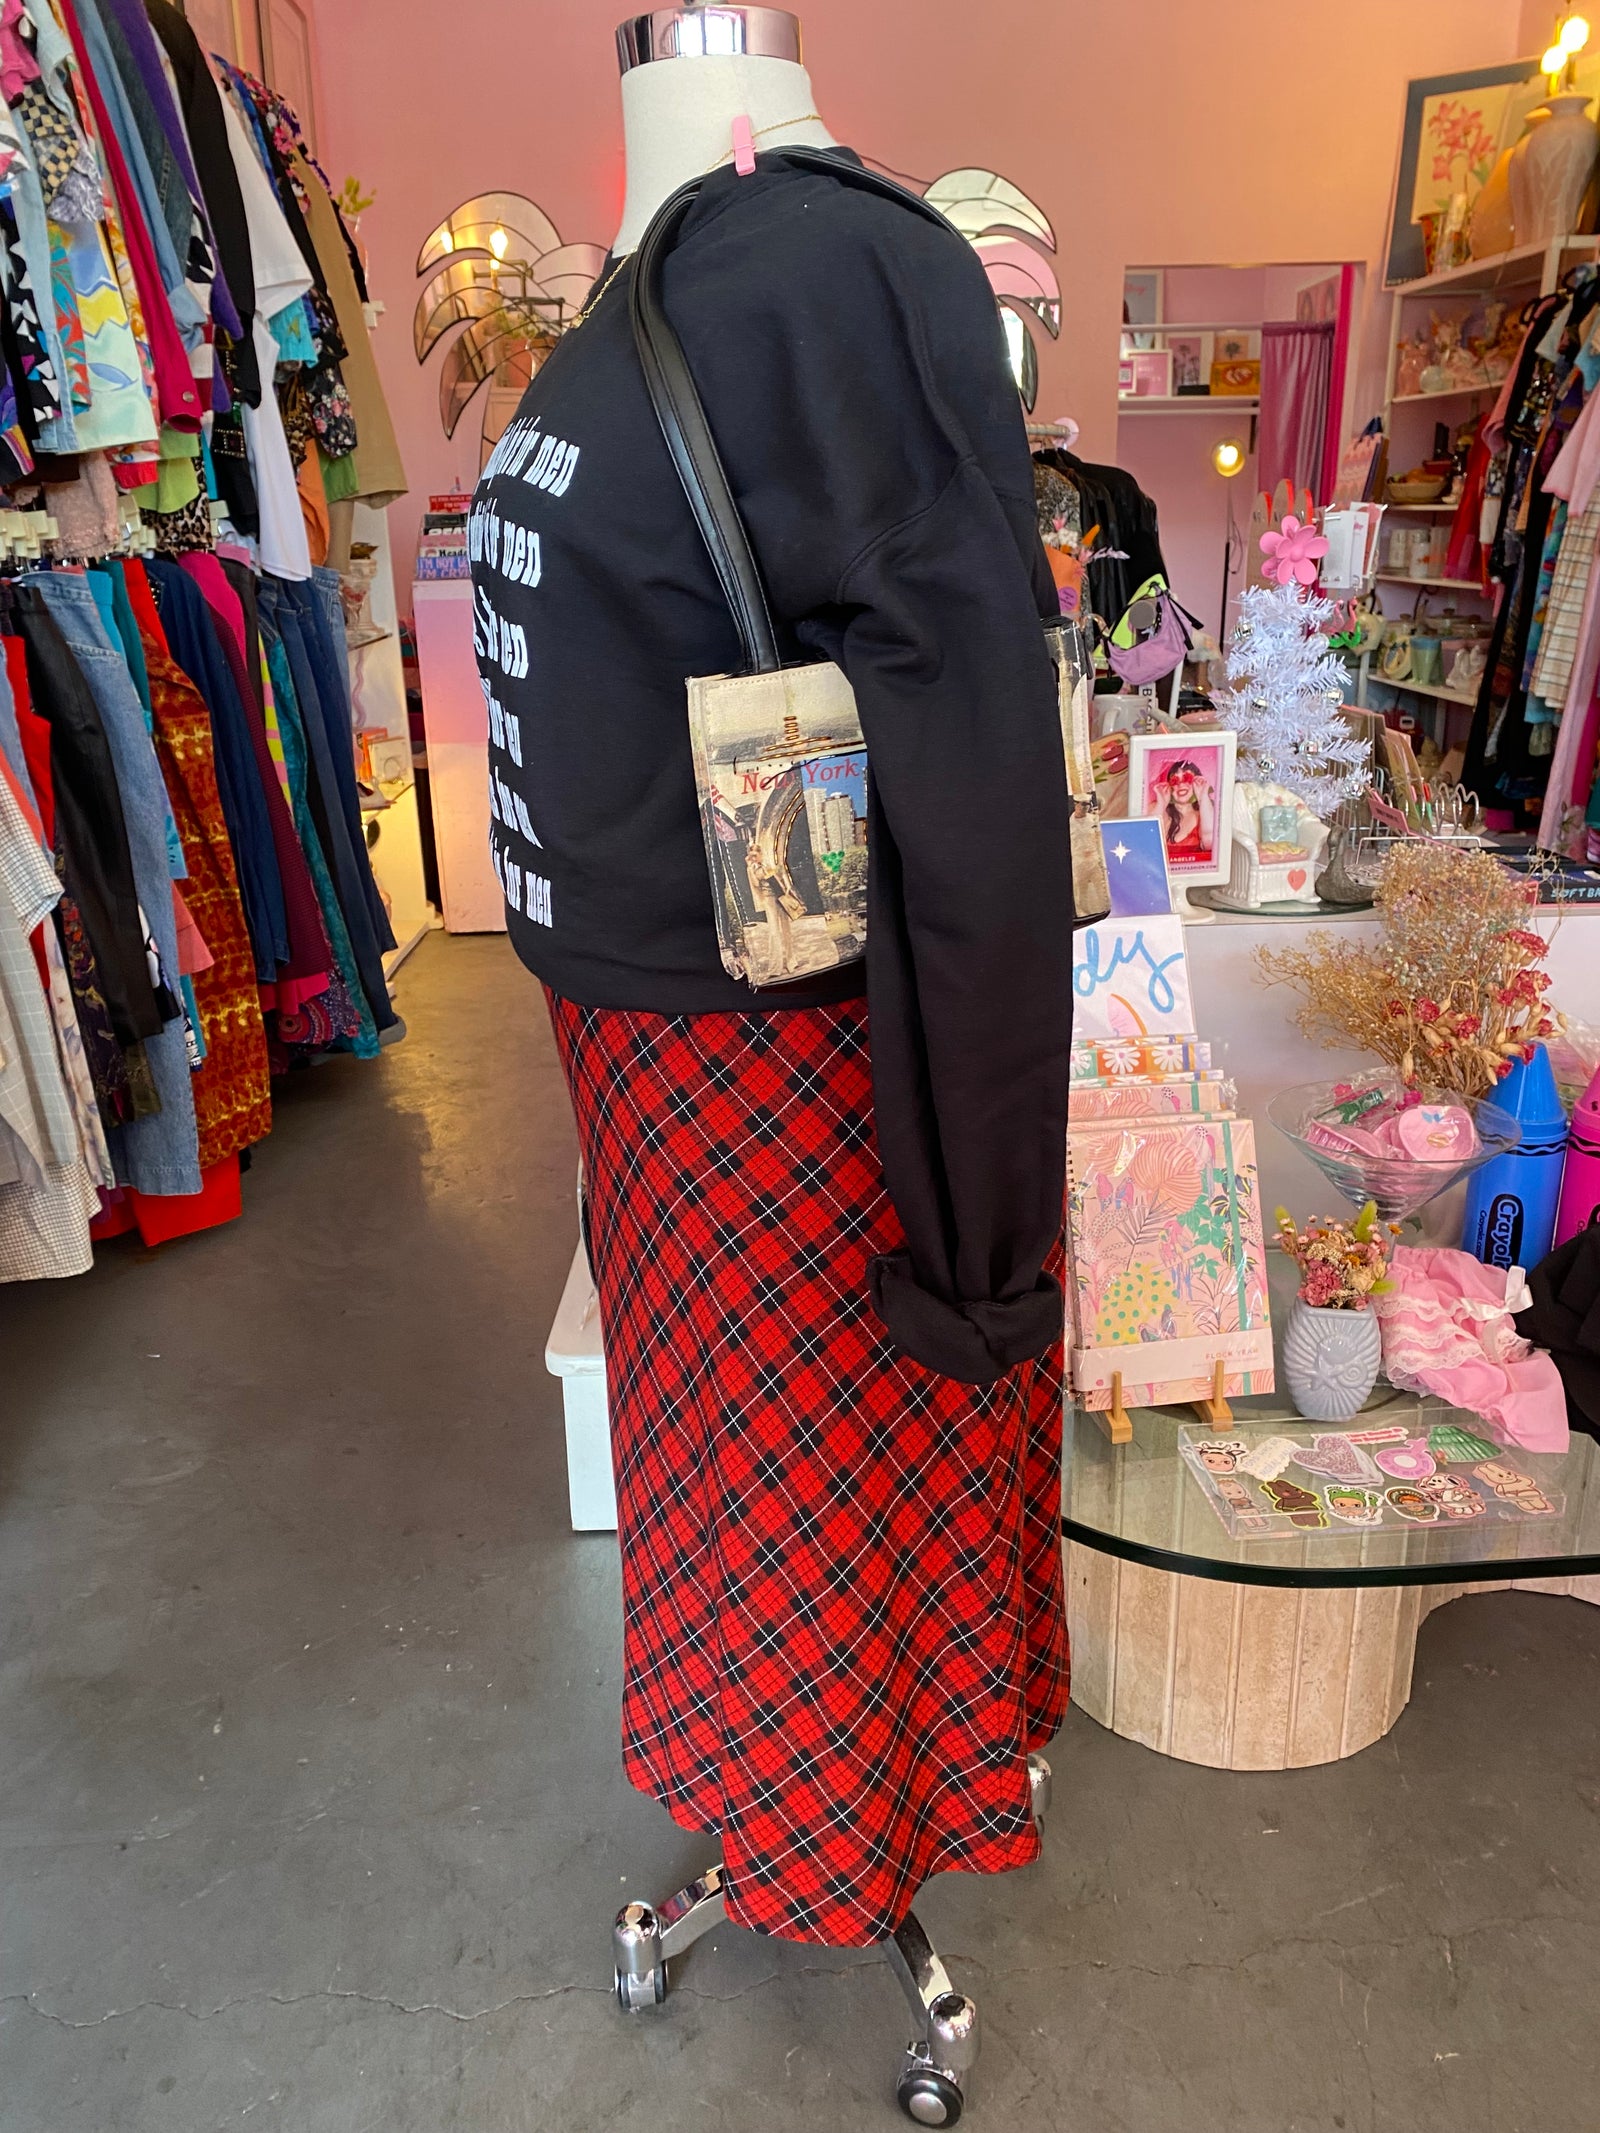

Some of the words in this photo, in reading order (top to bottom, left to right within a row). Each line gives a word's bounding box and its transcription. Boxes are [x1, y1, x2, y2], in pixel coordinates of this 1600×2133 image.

[522, 434, 580, 497] men
[804, 758, 860, 784] York
[525, 870, 553, 928] men
